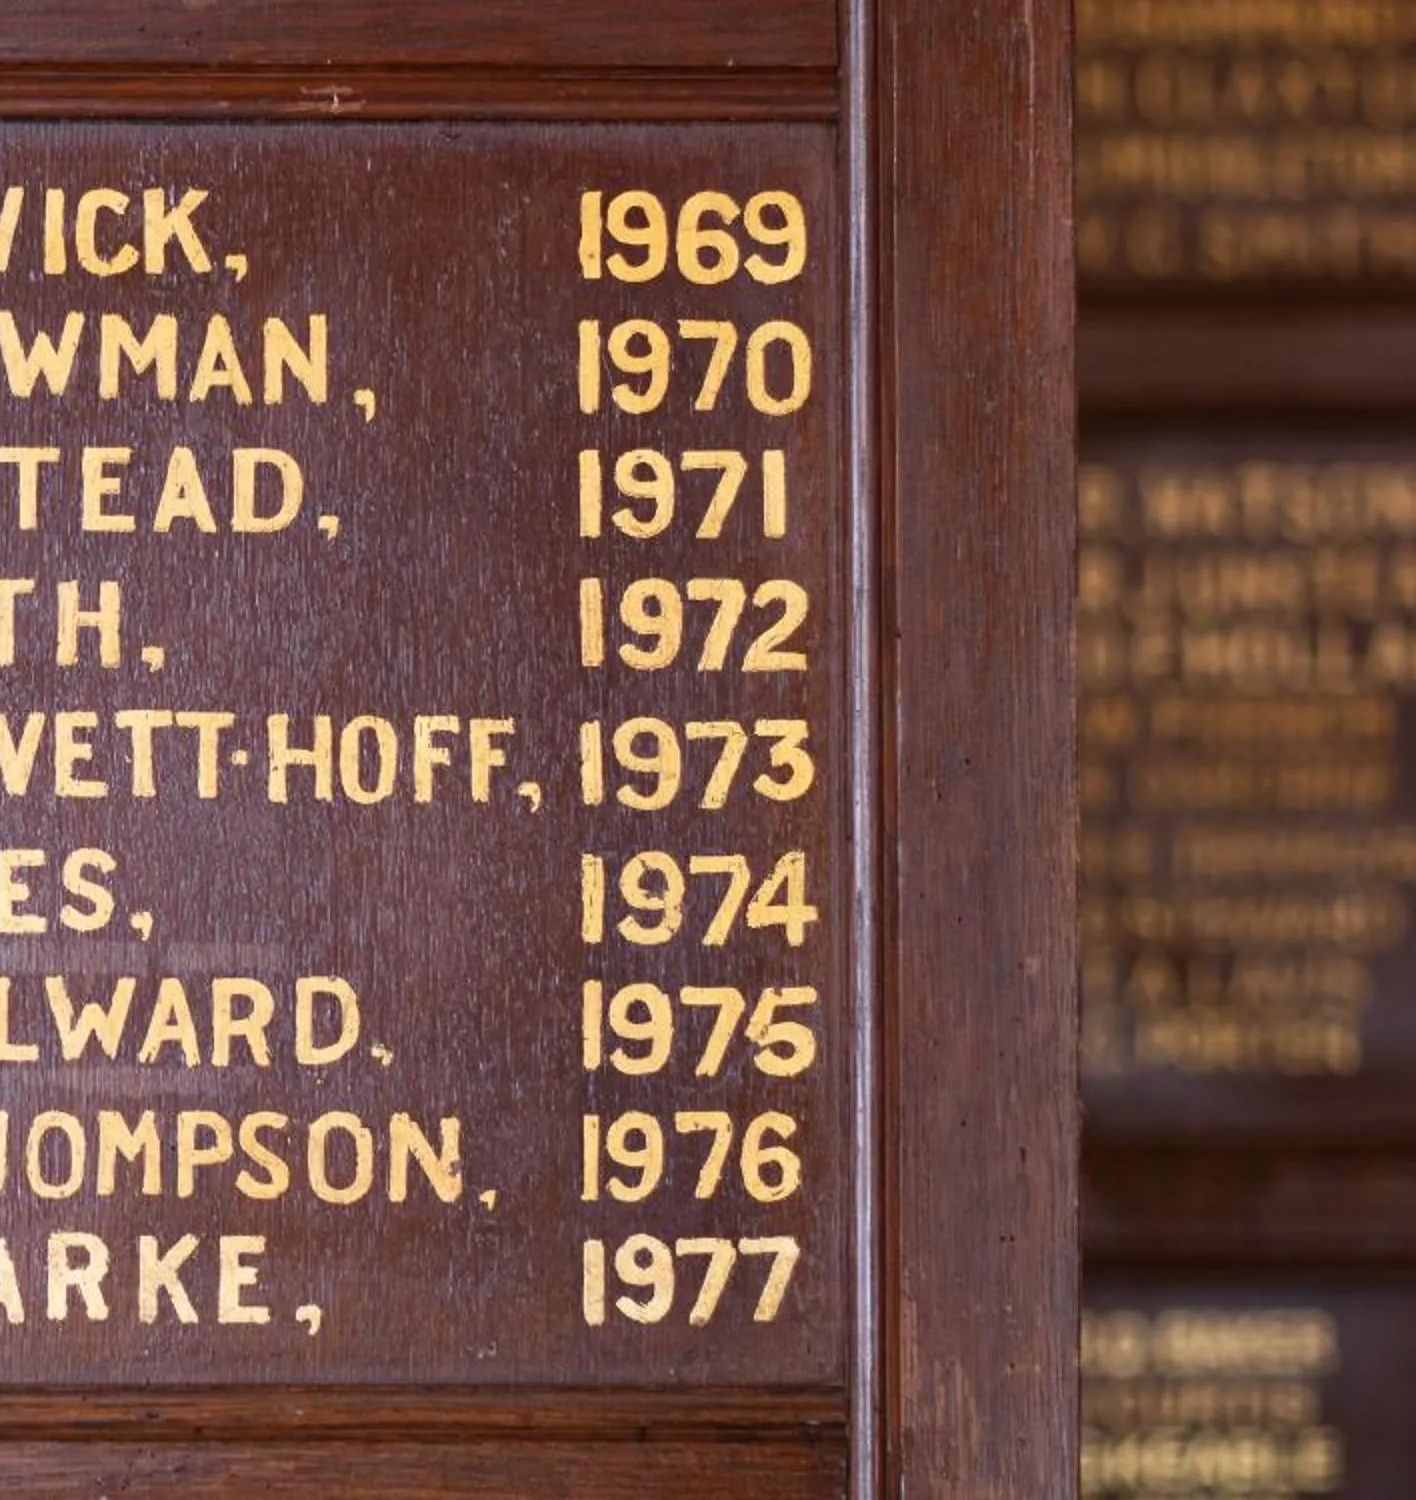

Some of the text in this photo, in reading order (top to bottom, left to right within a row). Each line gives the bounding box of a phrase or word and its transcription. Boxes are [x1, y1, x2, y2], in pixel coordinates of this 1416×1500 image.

[576, 189, 809, 286] 1969
[577, 317, 814, 418] 1970
[577, 447, 789, 541] 1971
[578, 575, 810, 674] 1972
[578, 715, 817, 812] 1973
[580, 849, 820, 948] 1974
[581, 978, 819, 1079] 1975
[581, 1108, 804, 1205] 1976
[582, 1233, 801, 1326] 1977
